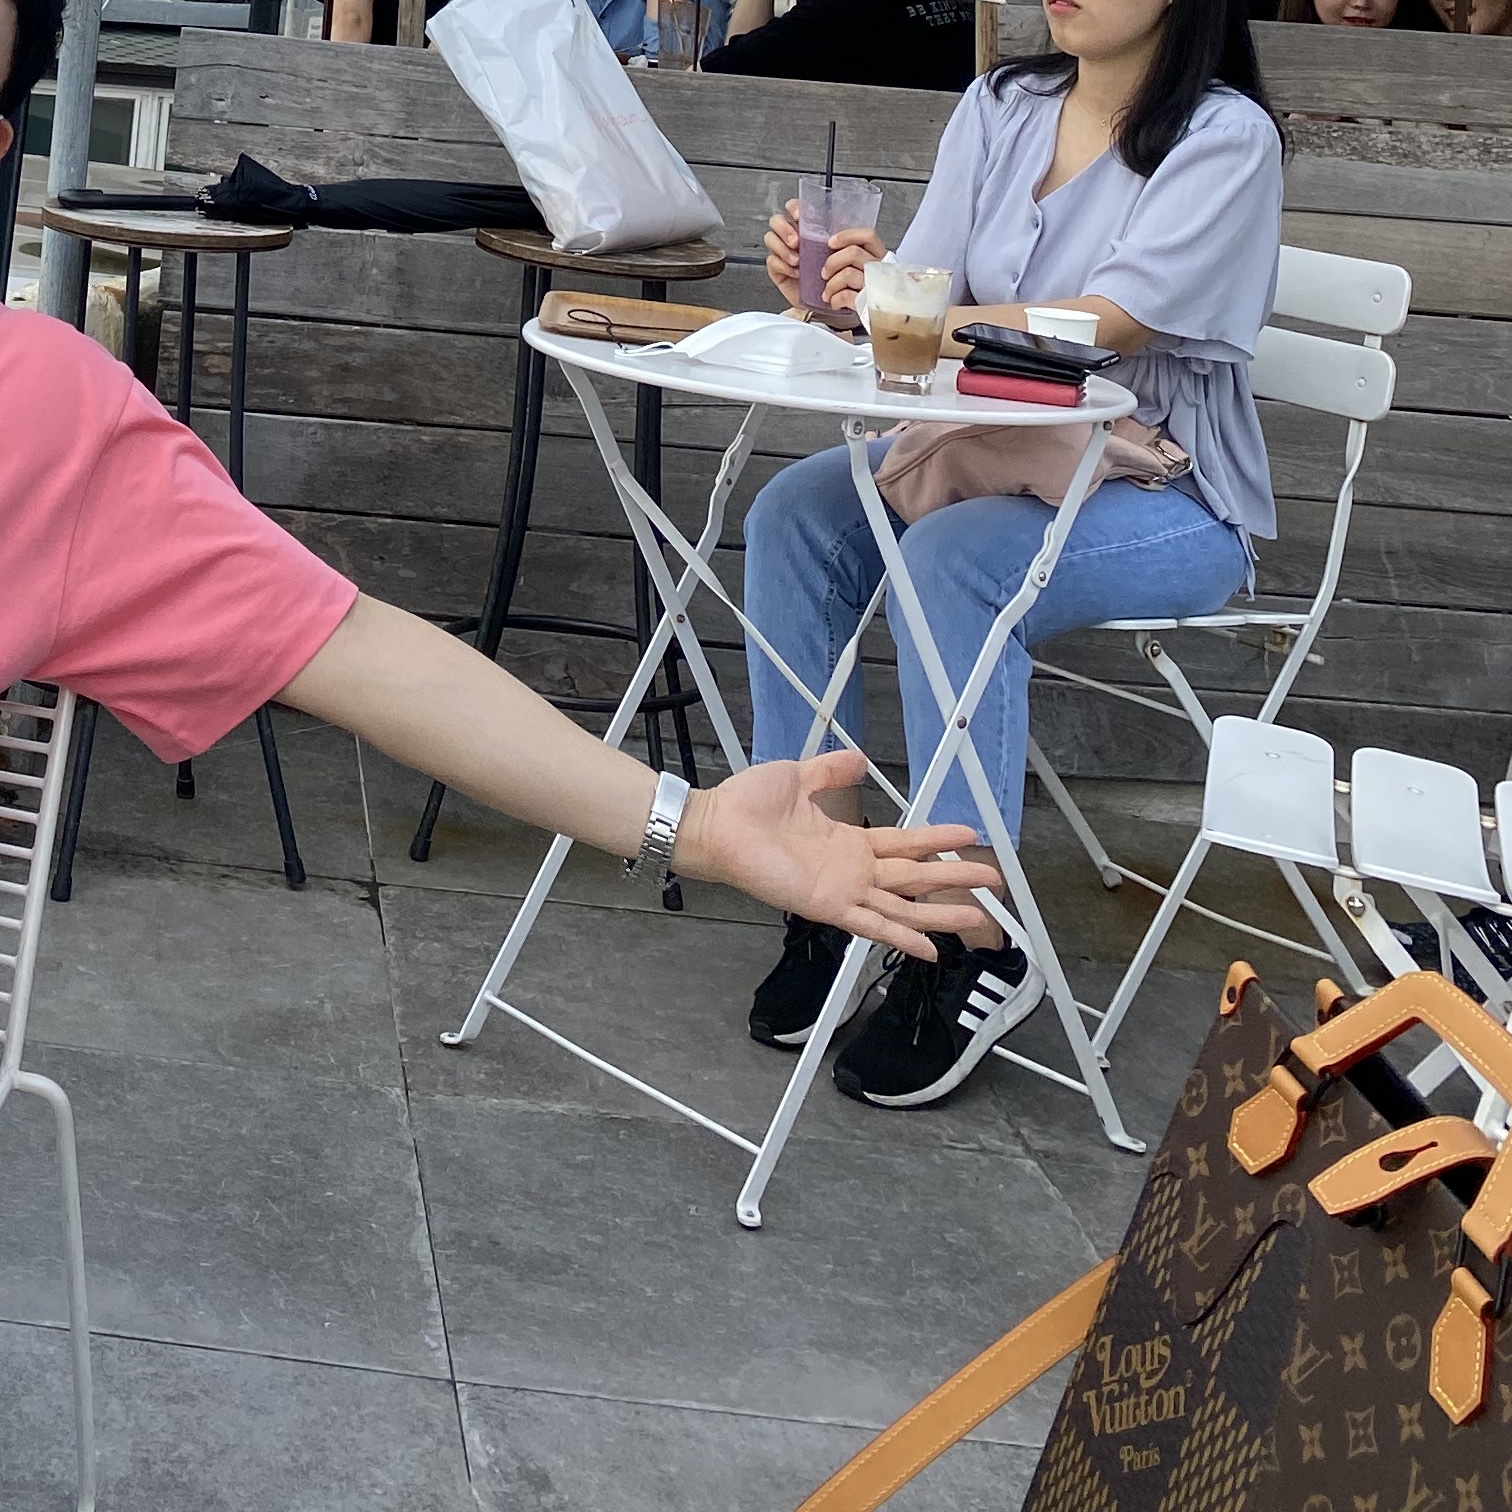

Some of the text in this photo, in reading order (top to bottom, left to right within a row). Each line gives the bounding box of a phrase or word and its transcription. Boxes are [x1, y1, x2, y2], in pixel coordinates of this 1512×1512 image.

[1096, 1320, 1172, 1389] Louis
[1082, 1382, 1187, 1438] Vuitton
[1118, 1441, 1161, 1473] Paris
